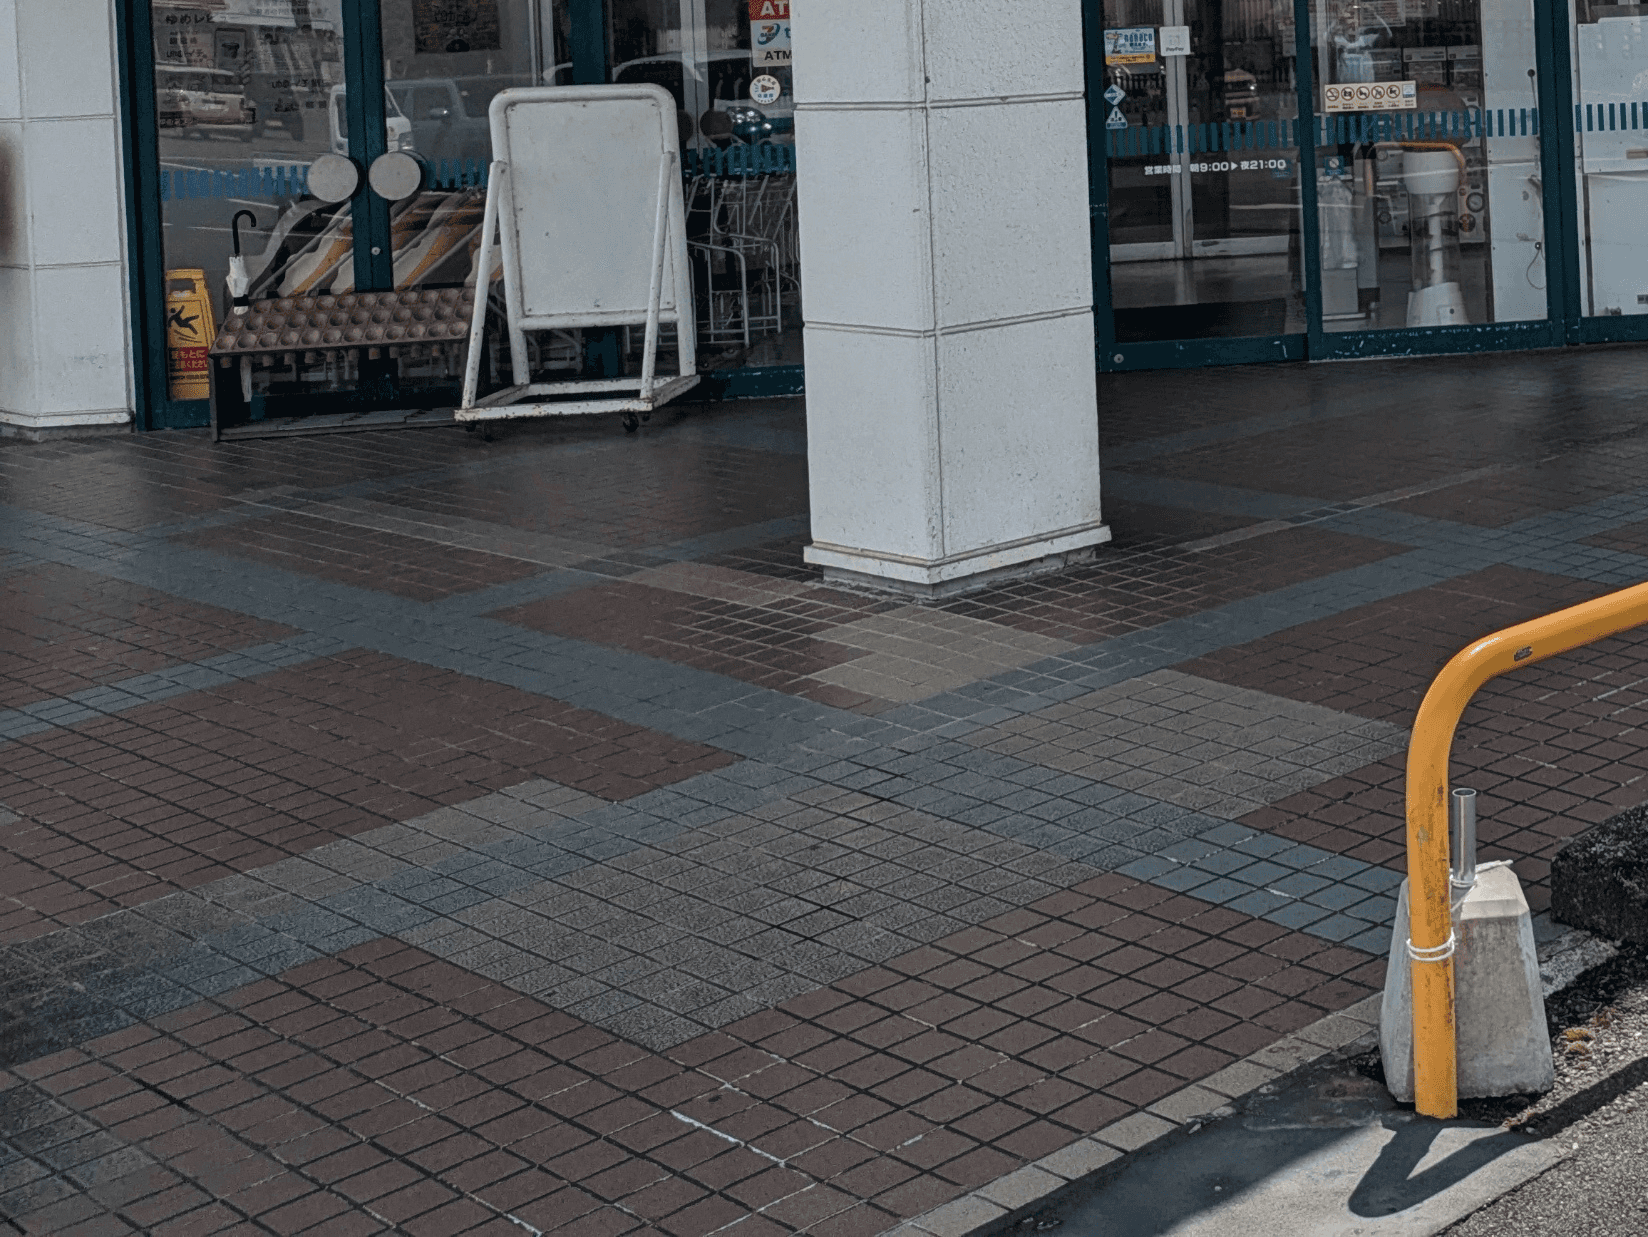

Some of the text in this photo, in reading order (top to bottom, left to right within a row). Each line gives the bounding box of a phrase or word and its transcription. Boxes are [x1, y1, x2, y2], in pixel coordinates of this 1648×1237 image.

[760, 0, 788, 16] AT
[1144, 164, 1182, 175] 営業時間
